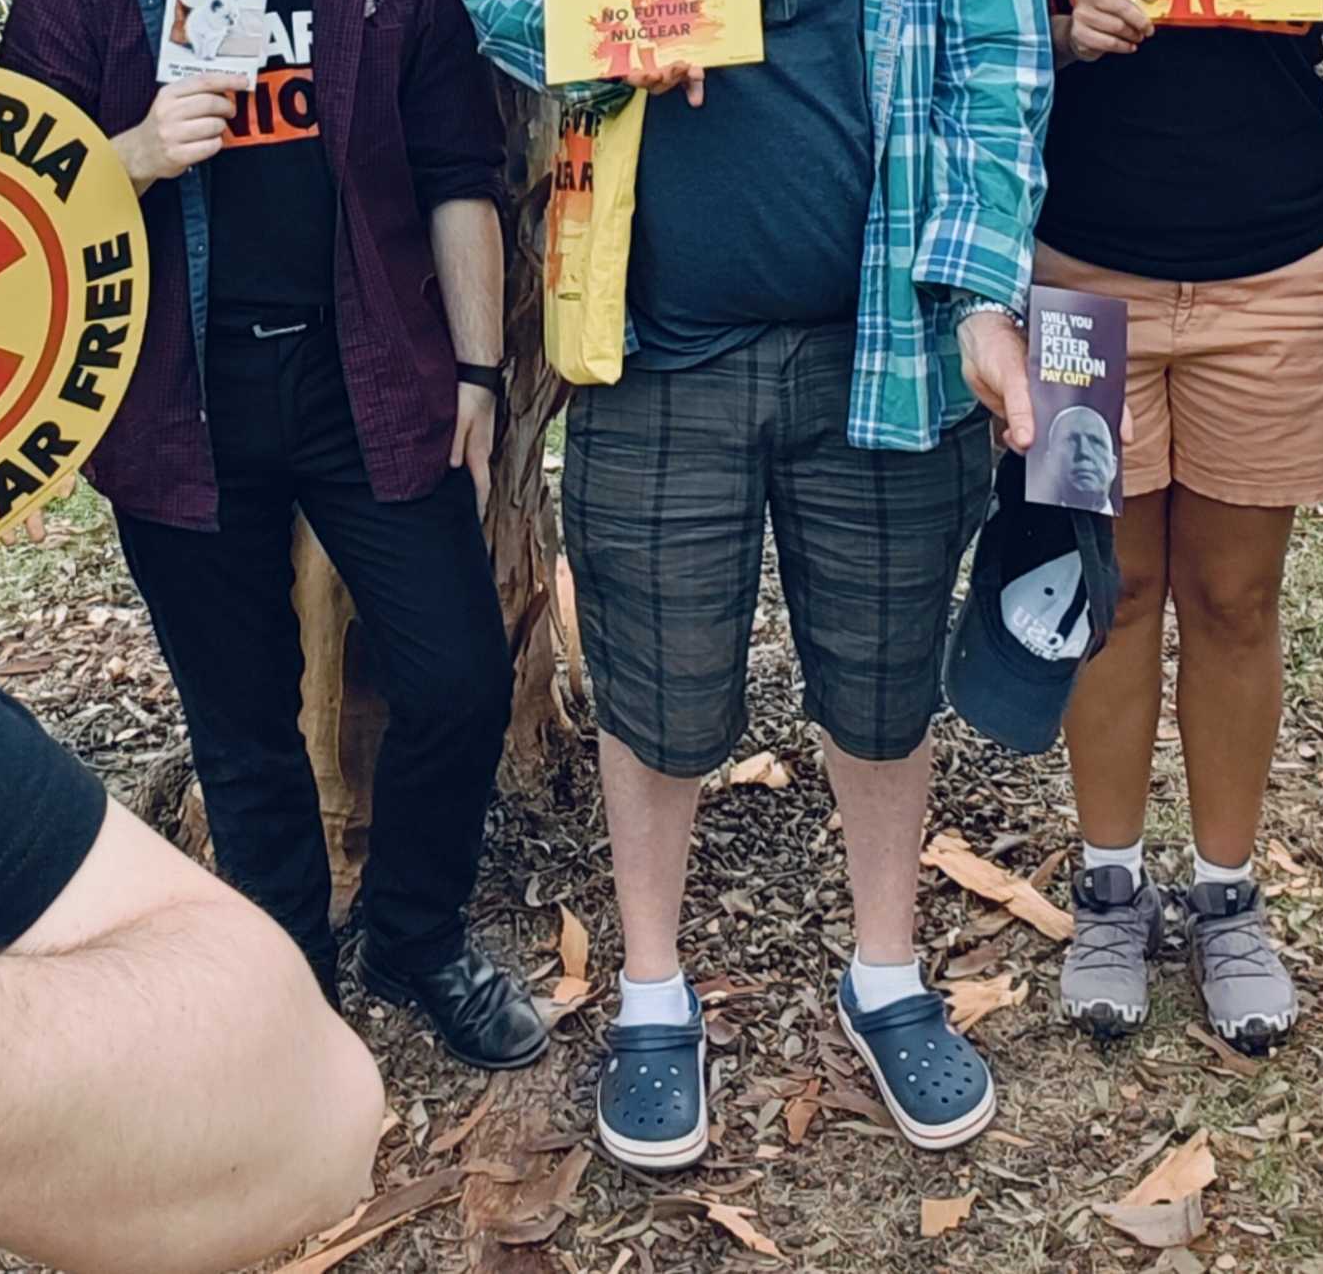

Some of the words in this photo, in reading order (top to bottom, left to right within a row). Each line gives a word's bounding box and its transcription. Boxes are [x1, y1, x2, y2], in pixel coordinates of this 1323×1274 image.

[601, 7, 629, 23] NO
[634, 1, 700, 19] FUTURE
[611, 23, 691, 42] NUCLEAR
[59, 231, 133, 412] FREE
[1041, 310, 1068, 326] WILL
[1069, 314, 1094, 331] YOU
[1041, 323, 1062, 335] GET
[1063, 325, 1072, 337] A
[1041, 335, 1090, 358] PETER
[1040, 368, 1062, 382] PAY
[1041, 351, 1106, 378] DUTTON
